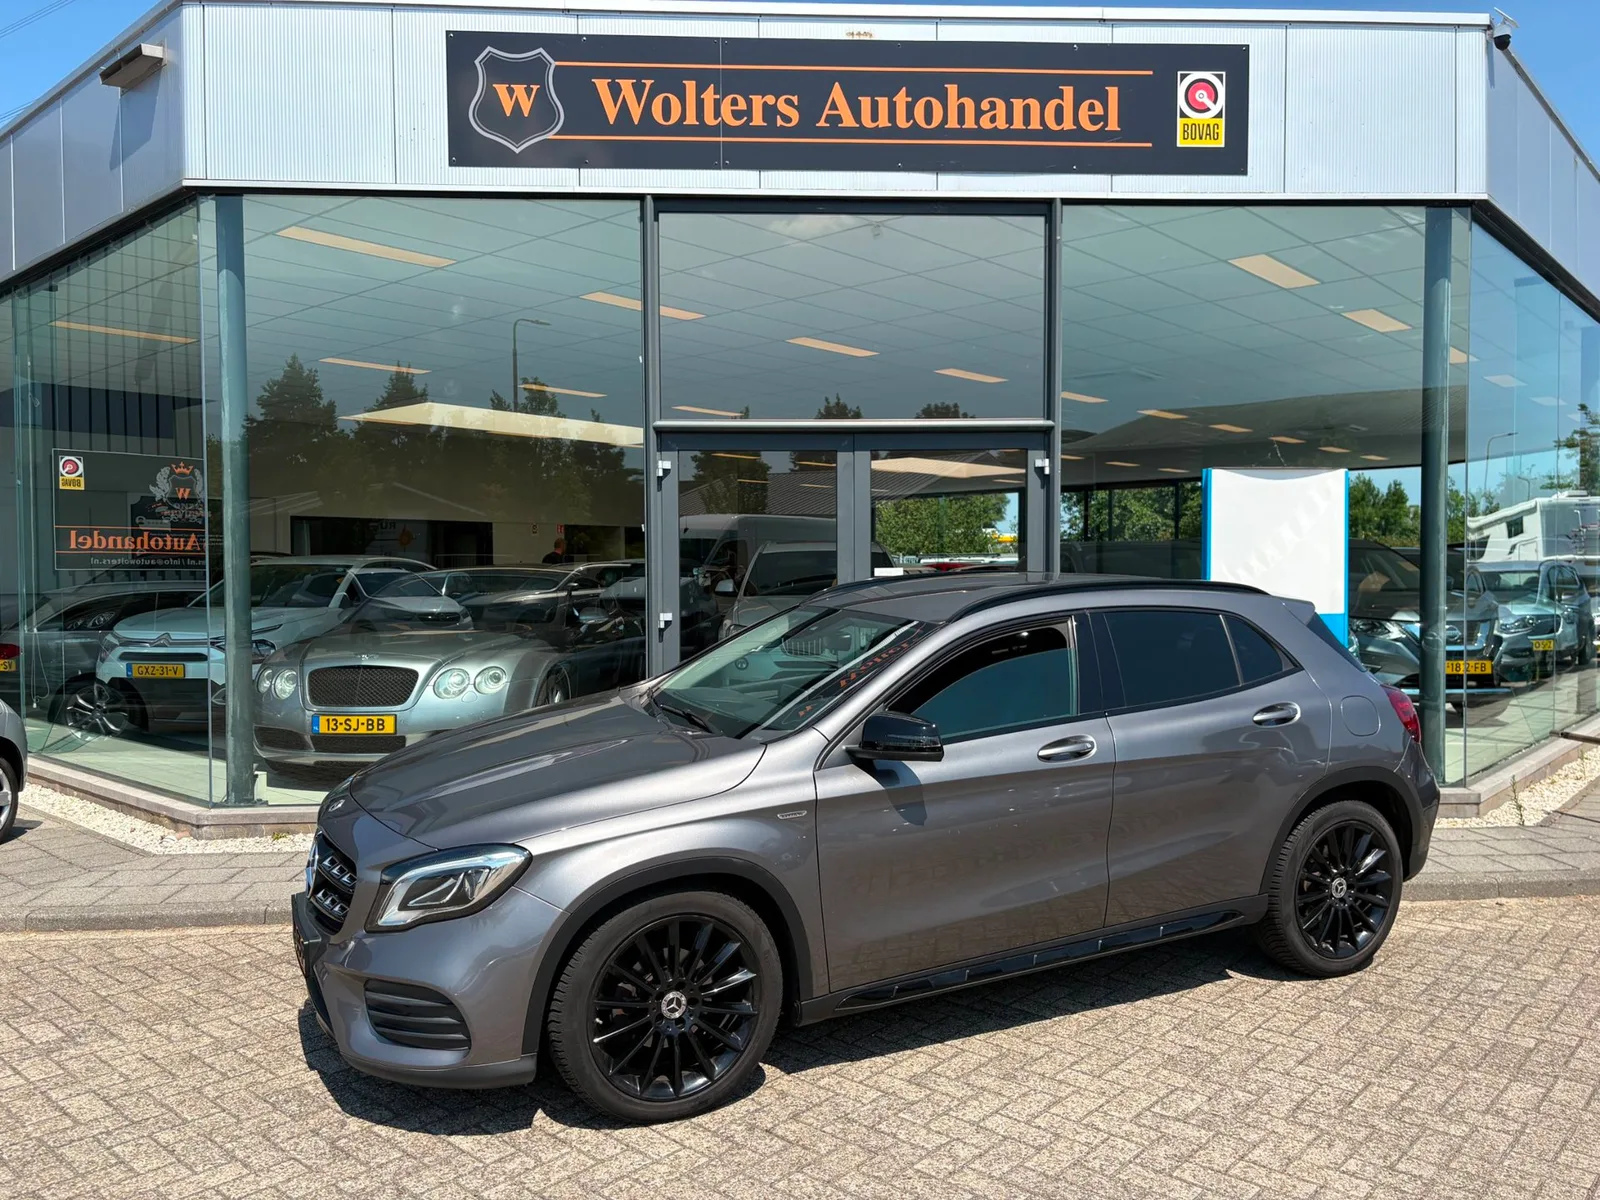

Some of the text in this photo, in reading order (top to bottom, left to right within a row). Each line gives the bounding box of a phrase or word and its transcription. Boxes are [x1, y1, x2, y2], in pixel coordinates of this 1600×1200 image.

[493, 84, 540, 118] W
[591, 79, 1121, 131] Wolters Autohandel
[1182, 123, 1220, 141] BOVAG
[137, 666, 178, 676] GXZ-31-V
[326, 718, 385, 731] 13-SJ-BB
